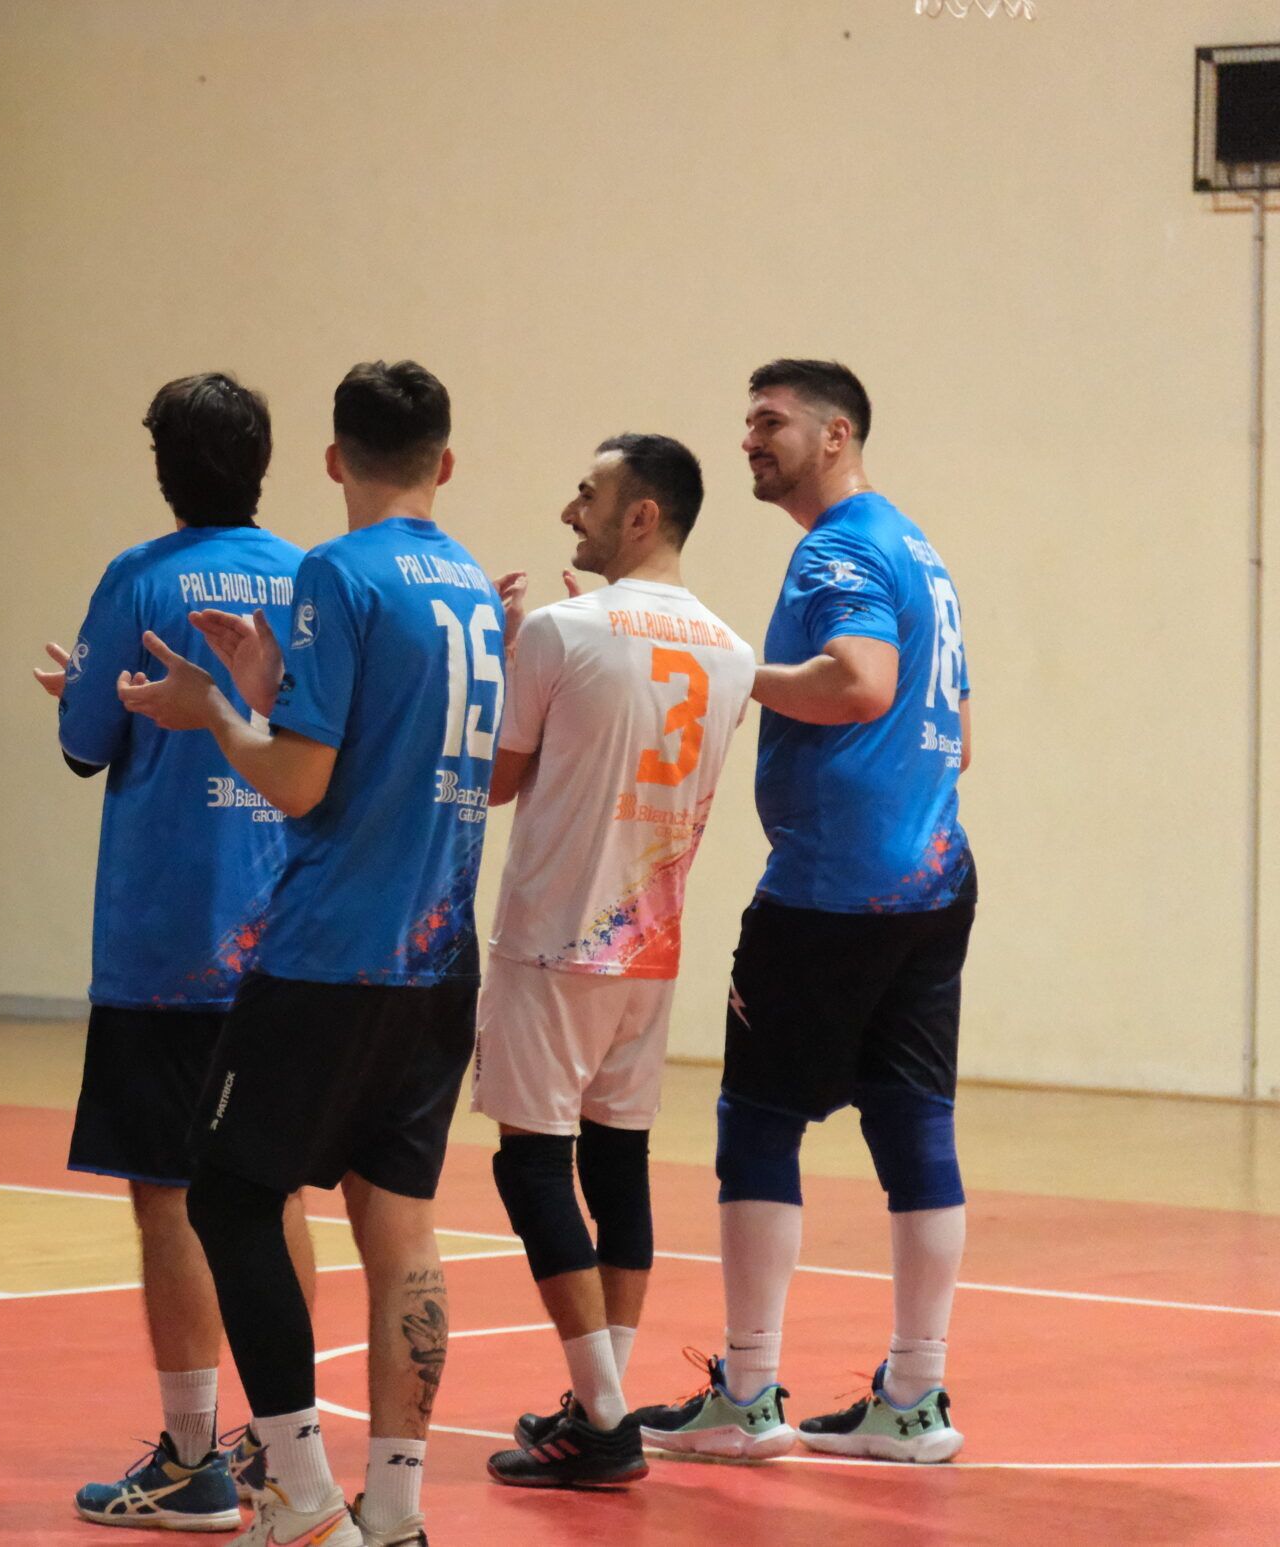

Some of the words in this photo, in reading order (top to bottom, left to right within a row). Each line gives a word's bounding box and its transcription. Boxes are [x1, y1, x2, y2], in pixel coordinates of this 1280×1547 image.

[179, 572, 268, 605] PALLAVOLO
[608, 610, 689, 644] PALLAVOLO
[689, 618, 735, 651] MILANI
[431, 599, 506, 761] 15
[925, 572, 962, 713] 18
[635, 646, 709, 787] 3
[216, 1070, 236, 1119] PATRICK
